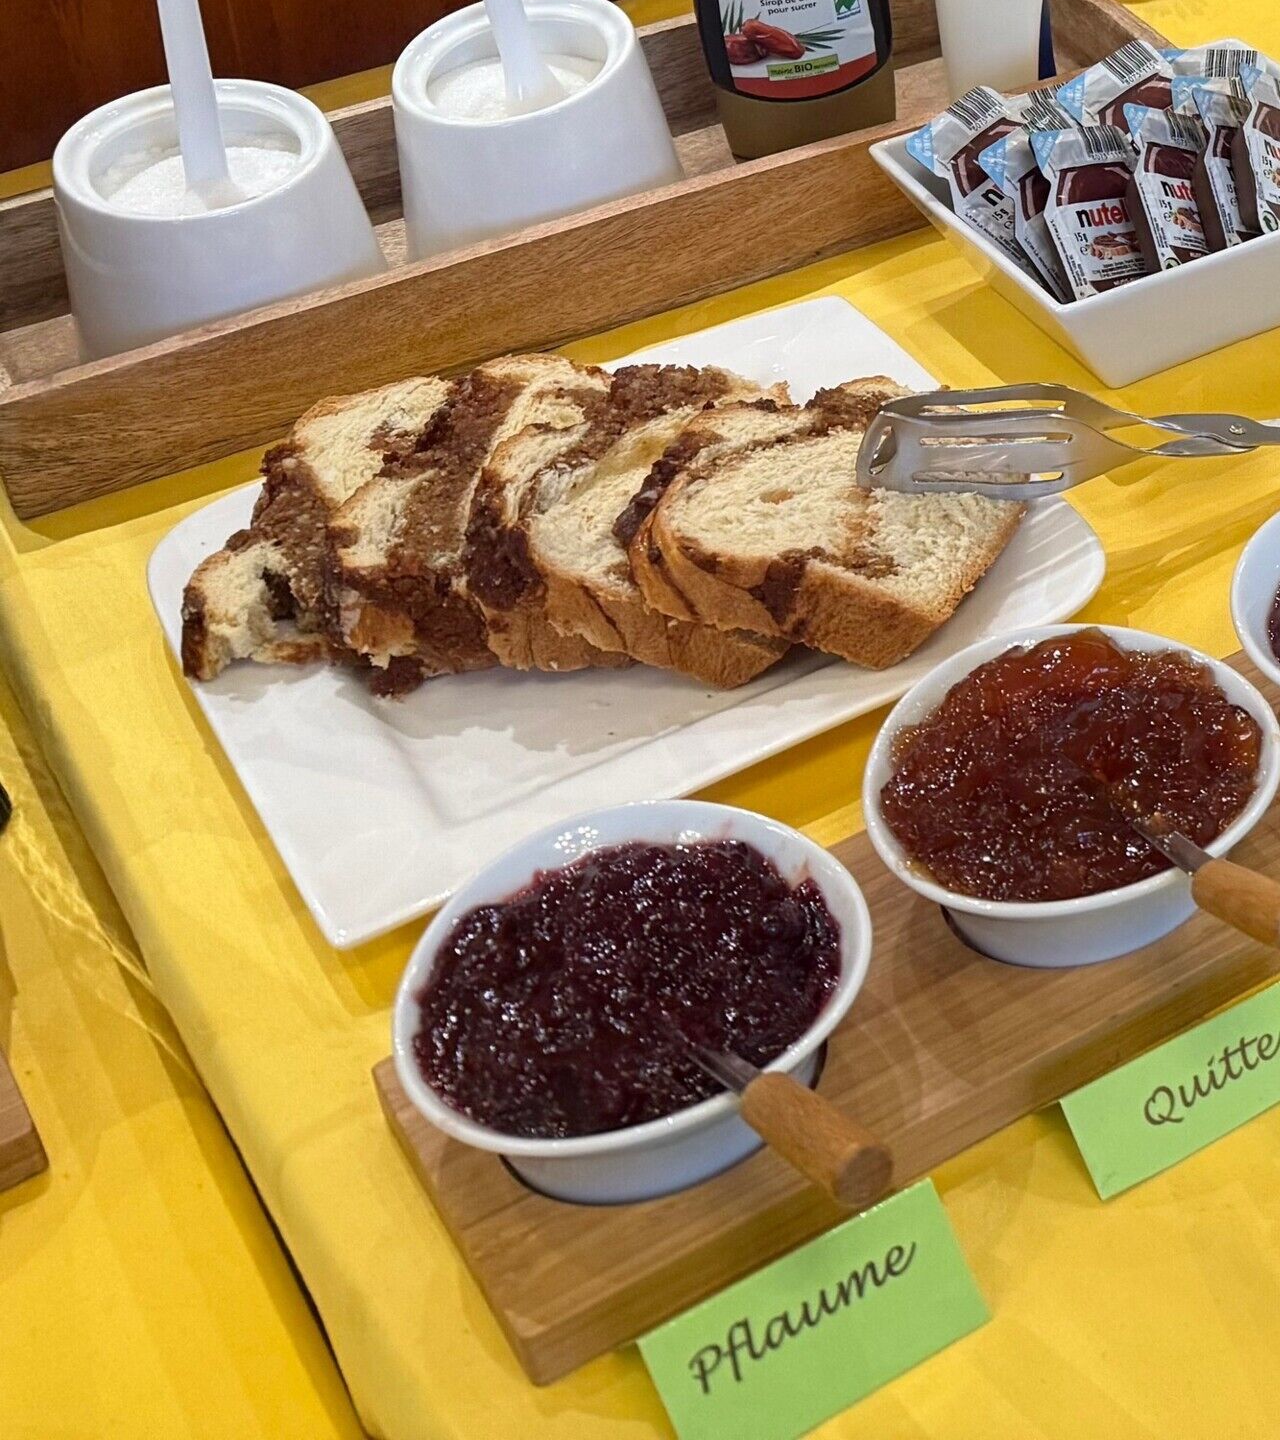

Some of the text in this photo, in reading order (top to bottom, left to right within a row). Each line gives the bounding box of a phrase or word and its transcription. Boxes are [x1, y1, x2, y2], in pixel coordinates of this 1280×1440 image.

[767, 1, 818, 16] pour sucrer
[794, 62, 813, 73] BIO
[1076, 201, 1130, 228] nutel
[687, 1241, 917, 1395] Pflaume
